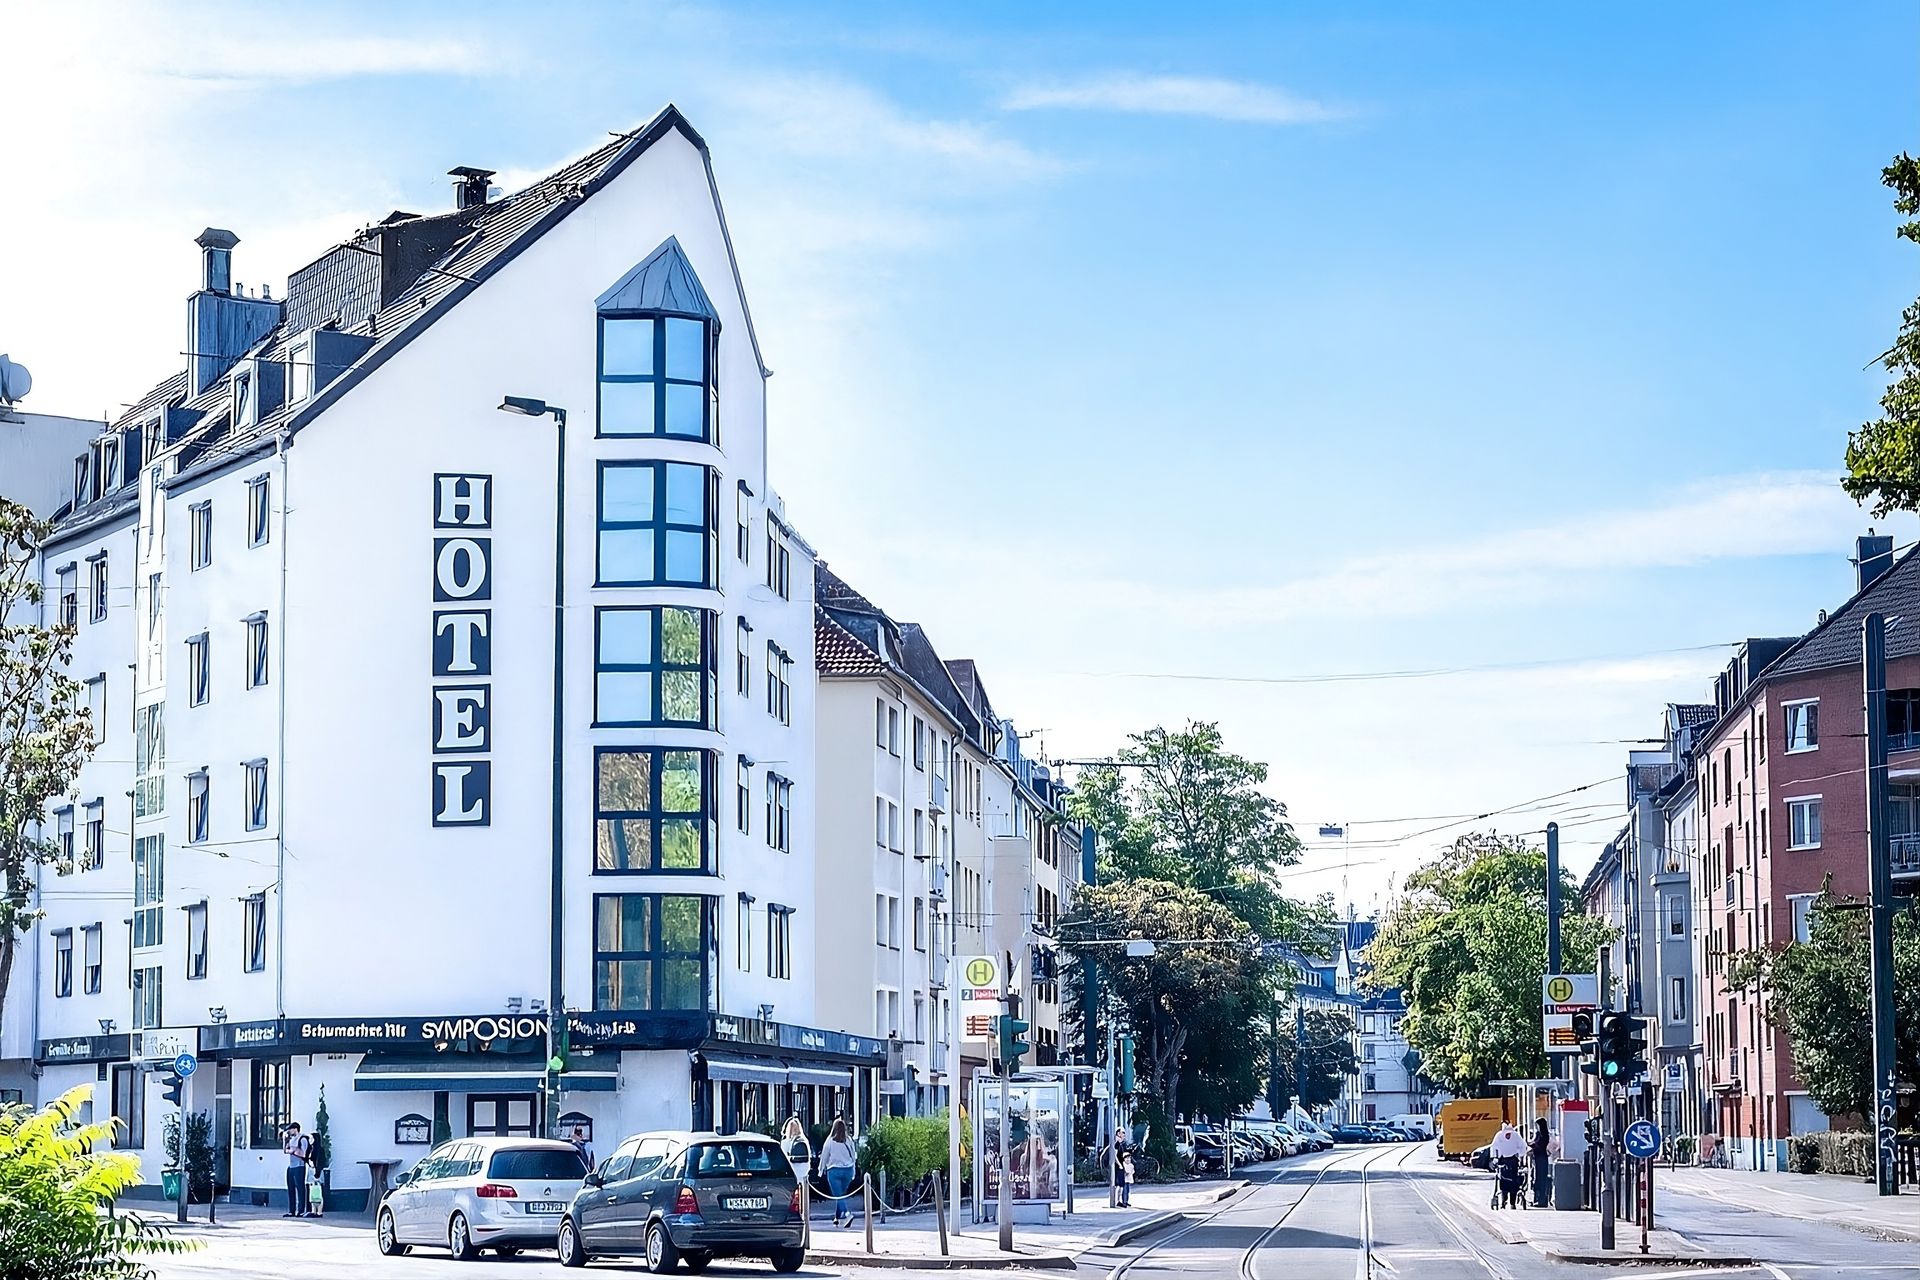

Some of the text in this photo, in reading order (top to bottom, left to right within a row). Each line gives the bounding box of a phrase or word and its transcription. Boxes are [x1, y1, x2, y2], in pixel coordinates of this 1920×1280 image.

[437, 476, 488, 822] HOTEL
[973, 963, 988, 981] H
[1553, 981, 1567, 998] H
[421, 1017, 549, 1041] SYMPOSION
[1456, 1112, 1493, 1121] DHL
